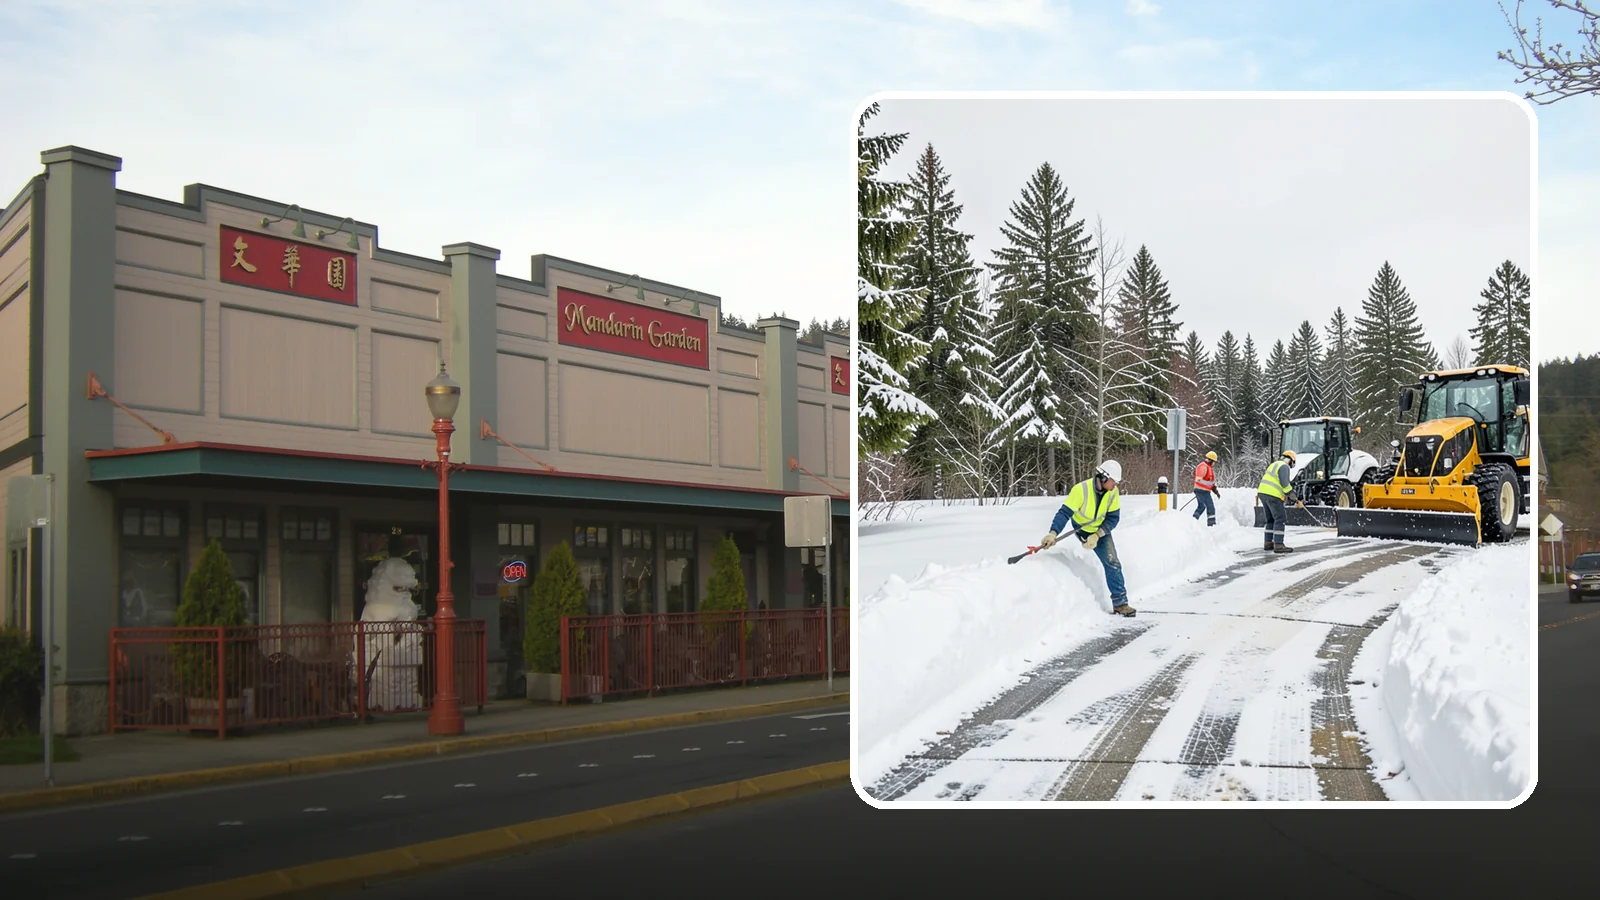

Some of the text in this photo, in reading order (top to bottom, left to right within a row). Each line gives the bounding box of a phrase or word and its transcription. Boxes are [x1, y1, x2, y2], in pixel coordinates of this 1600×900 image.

[231, 236, 346, 290] 文華園
[564, 302, 701, 352] Mandarin Garden
[503, 565, 527, 578] OPEN
